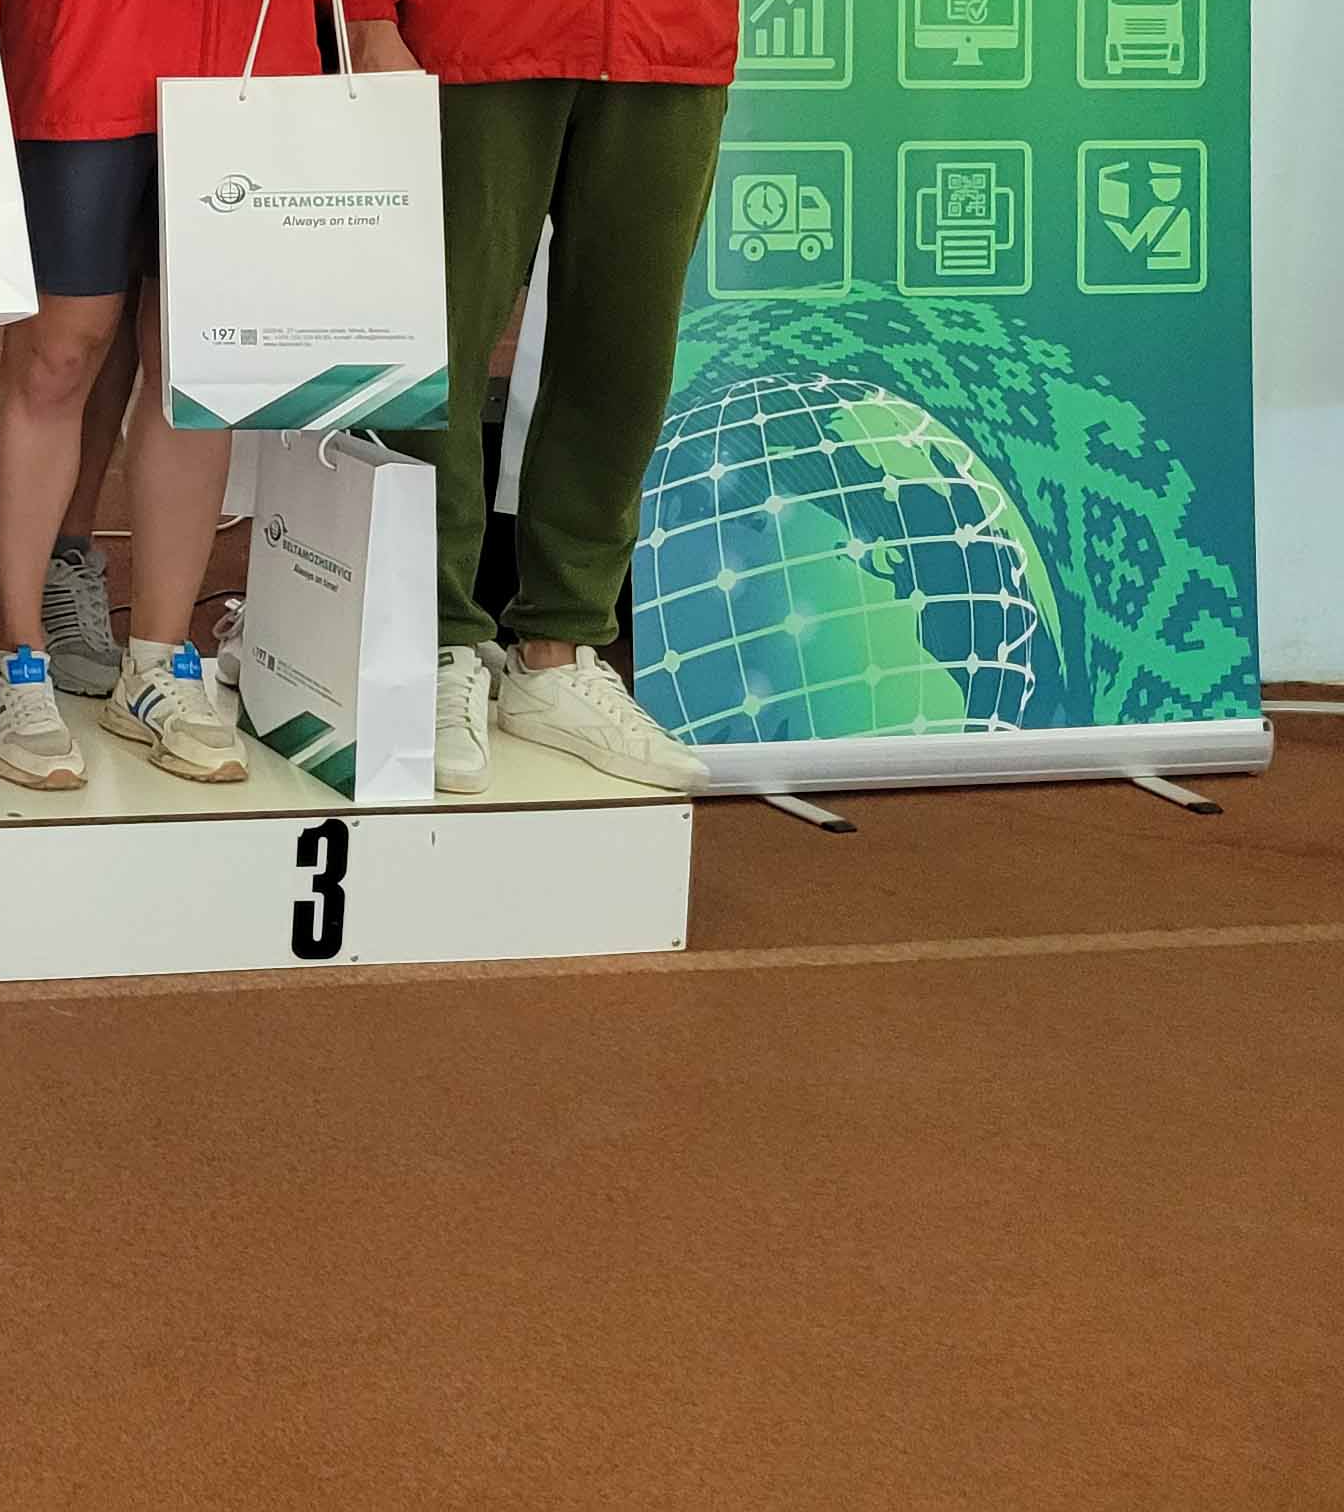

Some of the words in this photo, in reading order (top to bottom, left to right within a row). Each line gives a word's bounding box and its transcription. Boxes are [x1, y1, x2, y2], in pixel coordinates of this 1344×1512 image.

[253, 195, 409, 208] BELTAMOZHSERVICE
[282, 216, 326, 228] Always
[330, 217, 344, 226] on
[348, 215, 379, 226] time!
[211, 329, 236, 341] 197
[282, 539, 352, 583] BELTAMOZHSERVICE
[291, 818, 348, 960] 3
